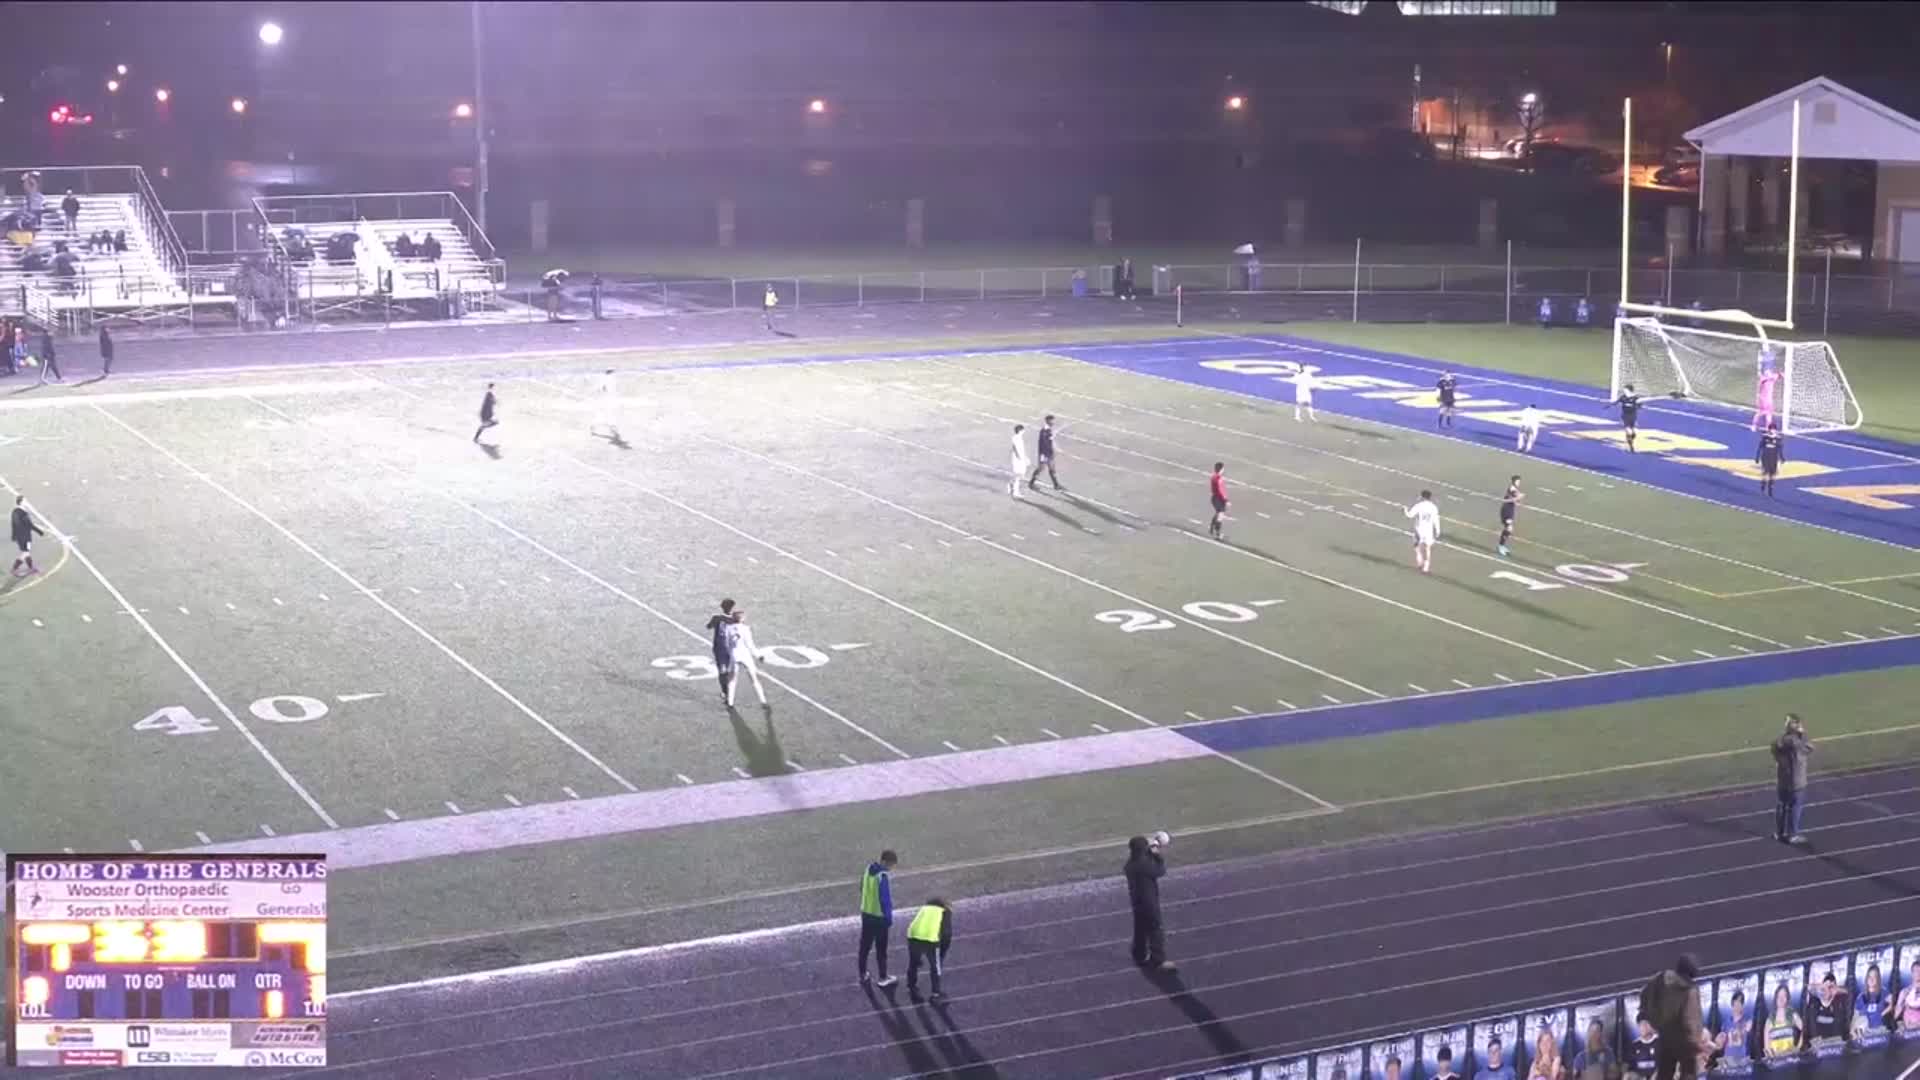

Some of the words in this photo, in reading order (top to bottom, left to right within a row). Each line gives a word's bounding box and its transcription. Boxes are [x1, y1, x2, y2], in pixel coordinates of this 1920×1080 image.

[23, 863, 94, 880] HOME
[102, 863, 135, 880] OF
[143, 863, 193, 880] THE
[200, 862, 327, 879] GENERALS
[66, 883, 131, 897] Wooster
[134, 882, 230, 898] Orthopaedic
[280, 881, 302, 895] Go
[66, 903, 111, 919] Sports
[115, 903, 179, 917] Medicine
[182, 903, 229, 917] Center
[65, 974, 107, 989] DOWN
[124, 974, 141, 989] TO
[144, 974, 164, 989] GO
[186, 974, 216, 989] BALL
[218, 974, 236, 989] ON
[254, 972, 282, 989] QTR
